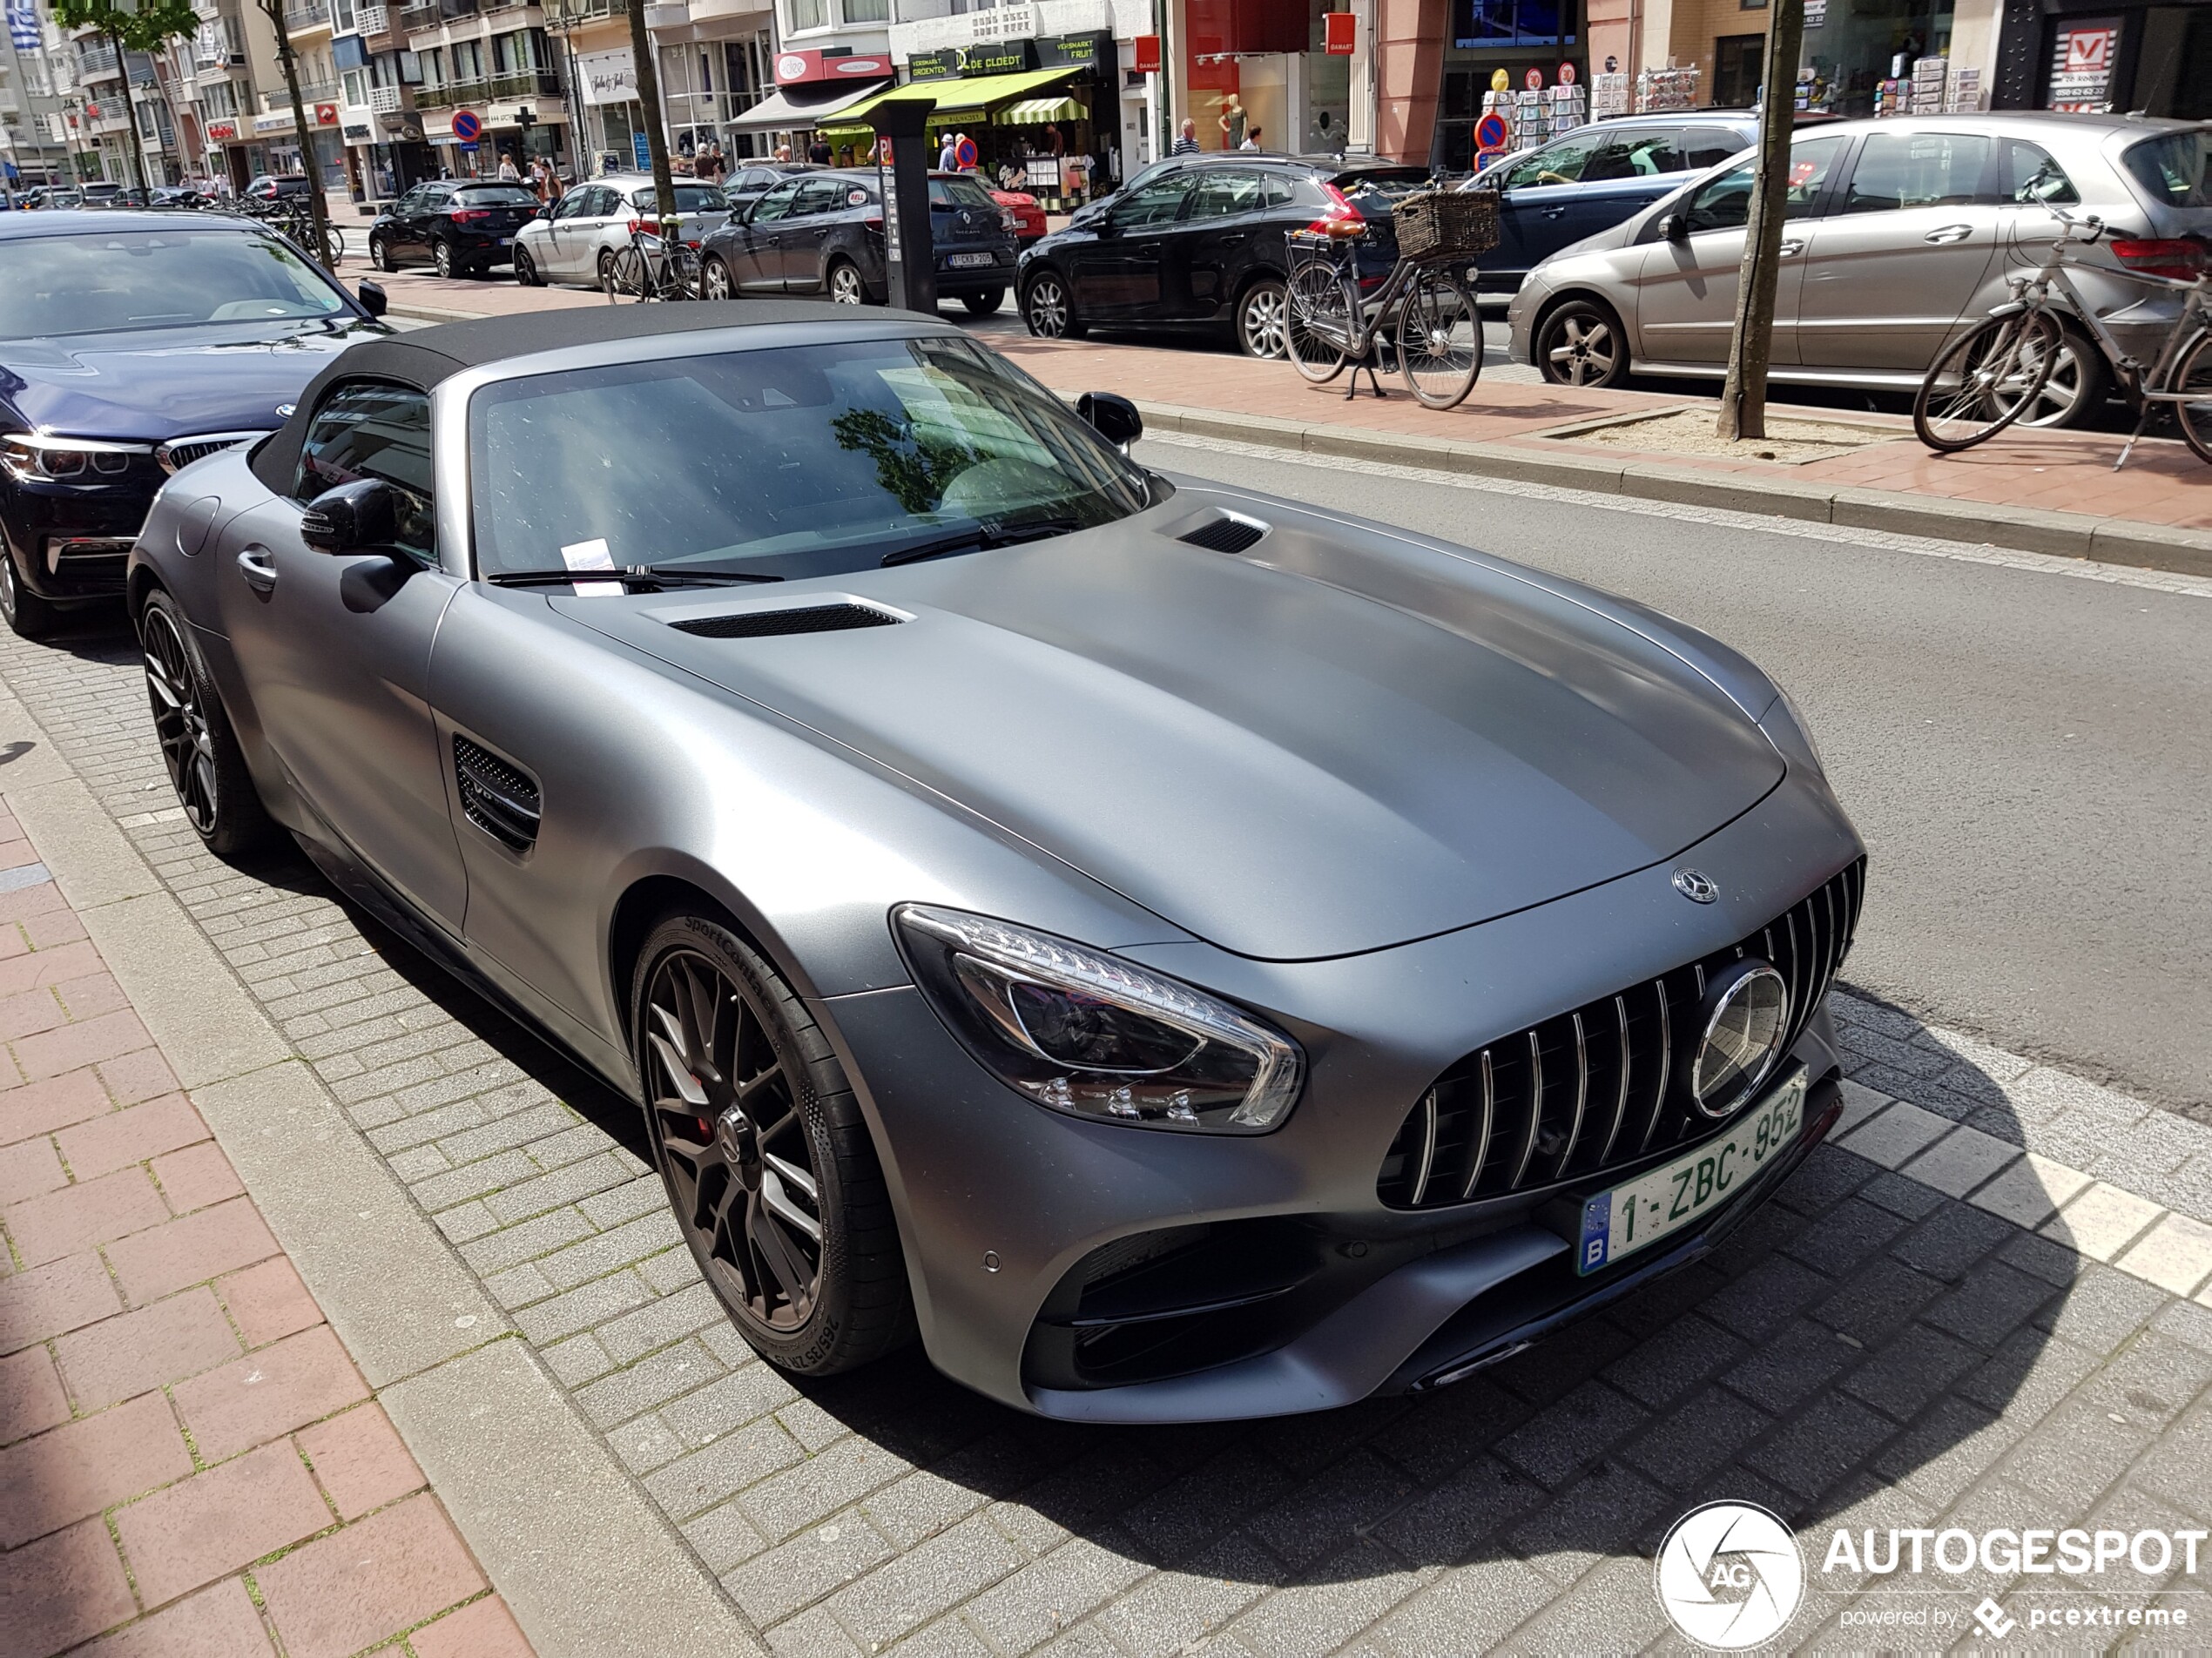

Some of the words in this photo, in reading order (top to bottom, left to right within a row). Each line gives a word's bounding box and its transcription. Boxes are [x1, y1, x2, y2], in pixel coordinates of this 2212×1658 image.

[1057, 40, 1093, 51] VERSMARKT
[1070, 50, 1093, 59] FRUIT
[912, 58, 941, 67] VERSMARKT
[971, 60, 982, 69] DE
[986, 55, 1020, 67] CLOEDT
[913, 66, 947, 76] GROENTEN
[1587, 1238, 1604, 1266] B
